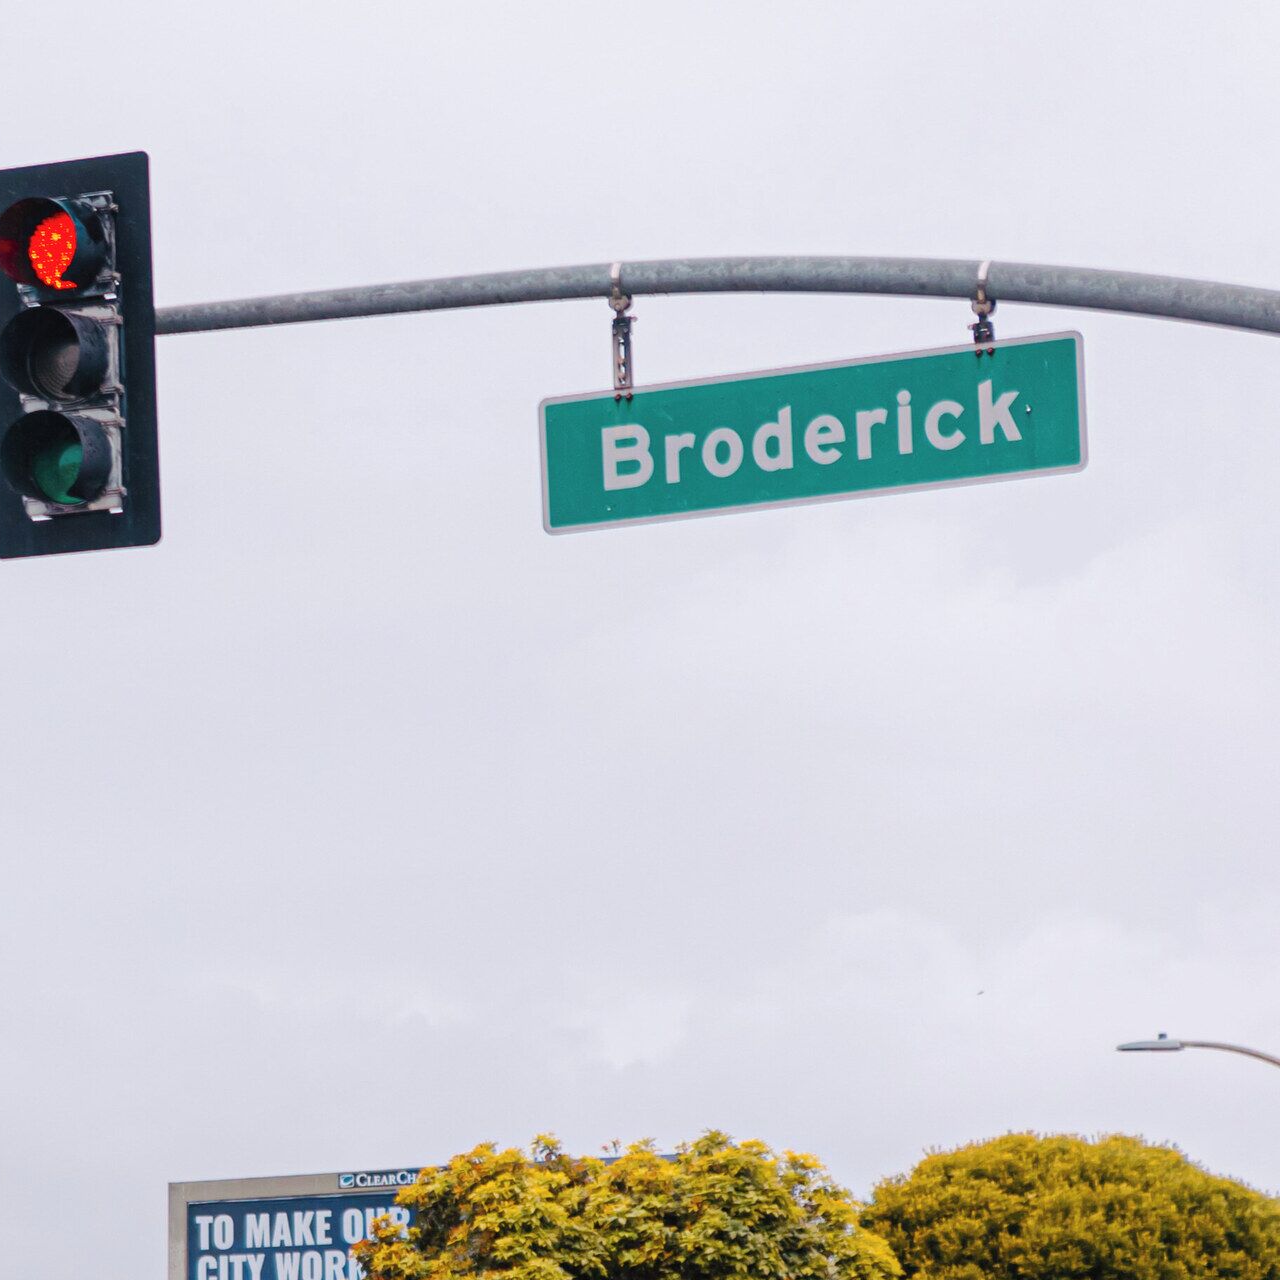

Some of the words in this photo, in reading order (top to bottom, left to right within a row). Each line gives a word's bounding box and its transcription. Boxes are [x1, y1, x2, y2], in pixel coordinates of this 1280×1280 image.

[600, 378, 1023, 492] Broderick
[356, 1171, 418, 1187] CLEARCH
[195, 1214, 234, 1250] TO
[245, 1210, 332, 1248] MAKE
